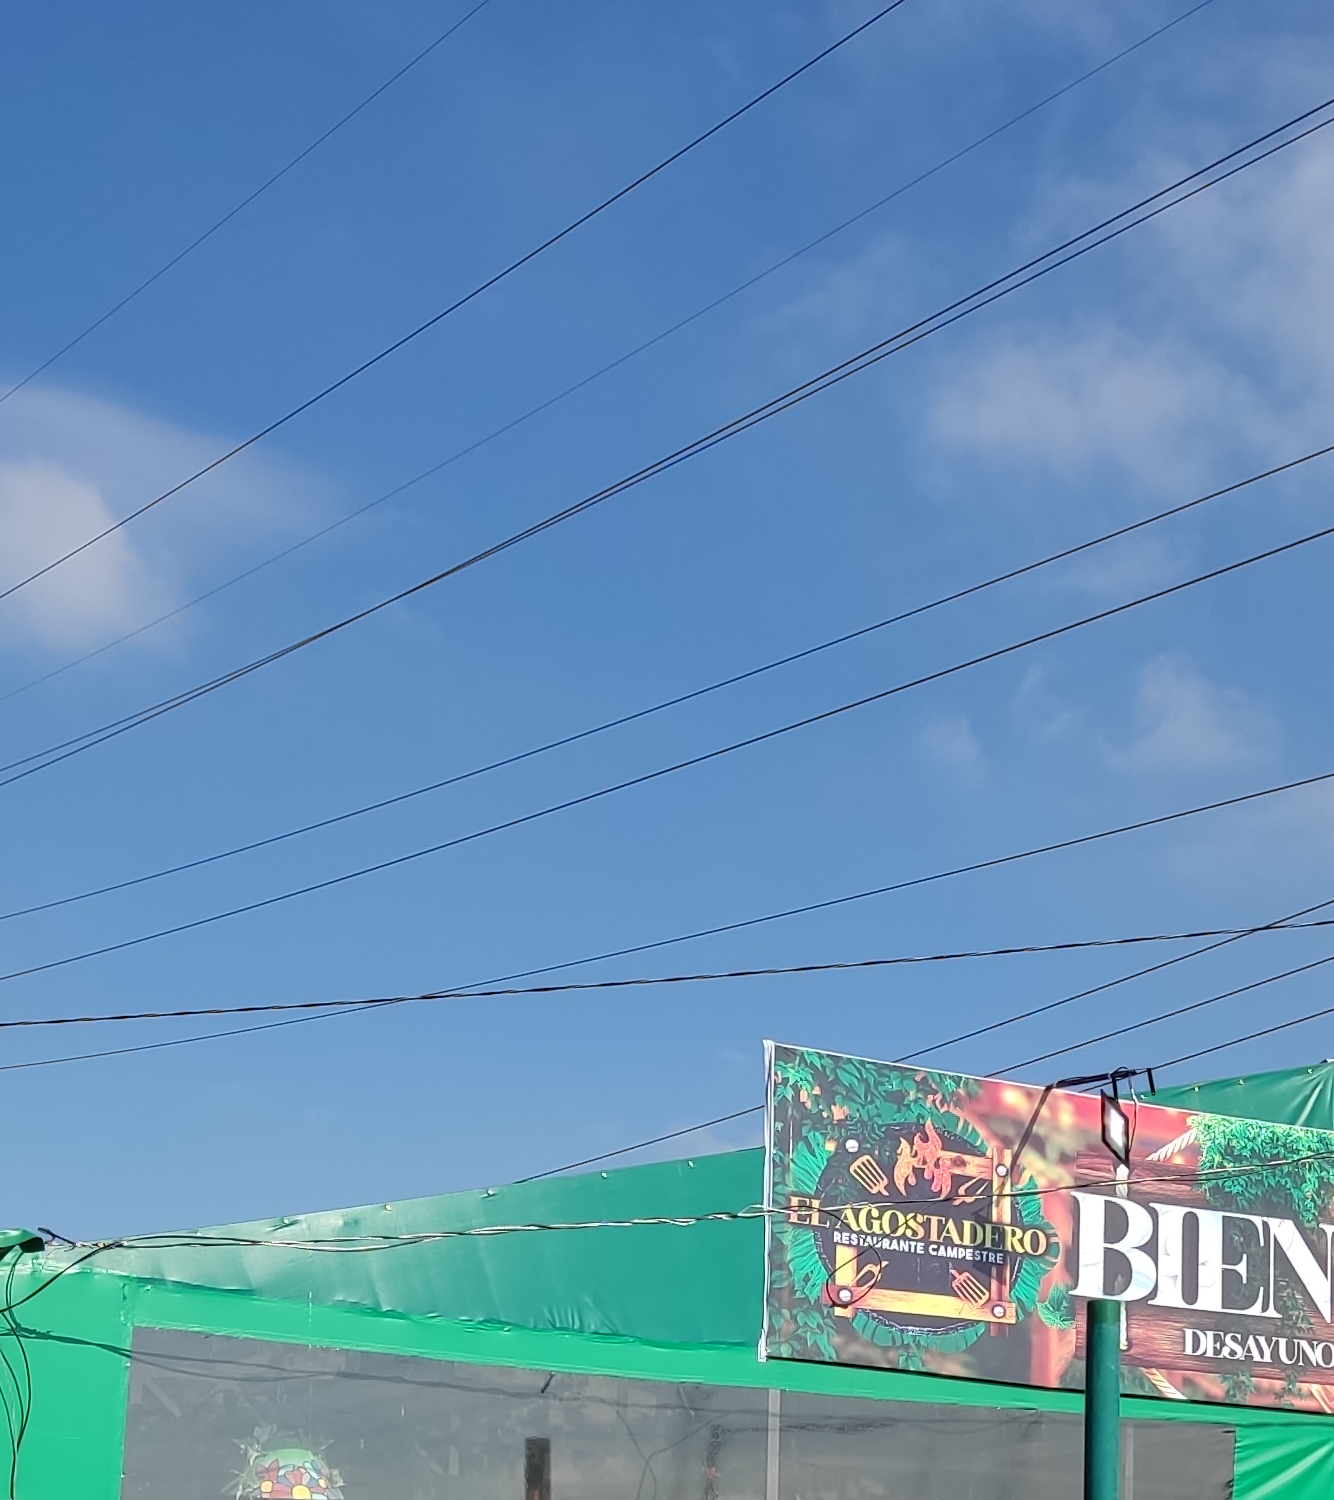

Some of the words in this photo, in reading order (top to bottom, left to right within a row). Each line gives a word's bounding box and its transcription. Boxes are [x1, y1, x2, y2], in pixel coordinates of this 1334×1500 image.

[788, 1195, 830, 1228] EL
[836, 1205, 1048, 1256] AGOSTADERO
[833, 1231, 925, 1254] RESTAURANTE
[928, 1245, 1004, 1264] CAMPESTRE
